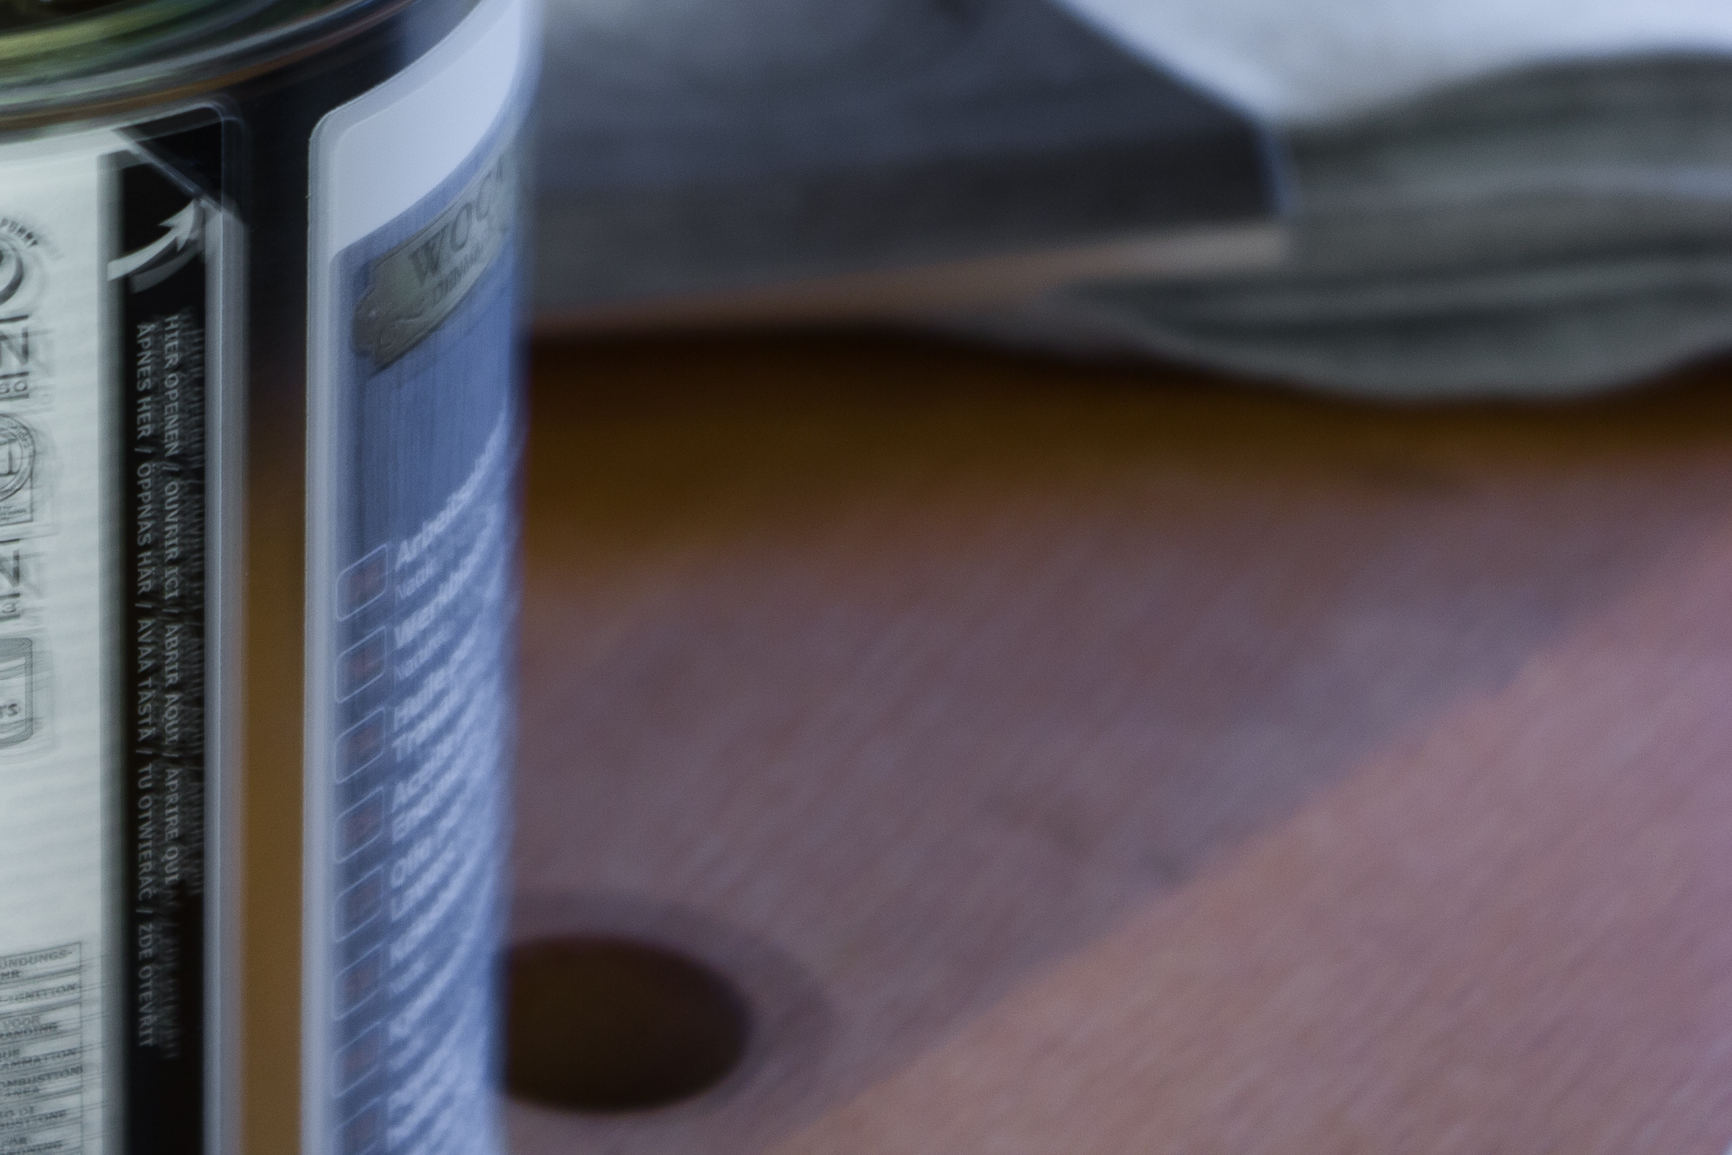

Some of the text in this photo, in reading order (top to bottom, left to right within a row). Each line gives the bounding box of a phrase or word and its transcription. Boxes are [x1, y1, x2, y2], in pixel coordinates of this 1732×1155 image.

[137, 398, 152, 439] HER
[164, 314, 180, 884] HIER OPENEN OUVRIR ICI ABRIR AQUI APRIRE QUI
[137, 618, 152, 673] AVAA
